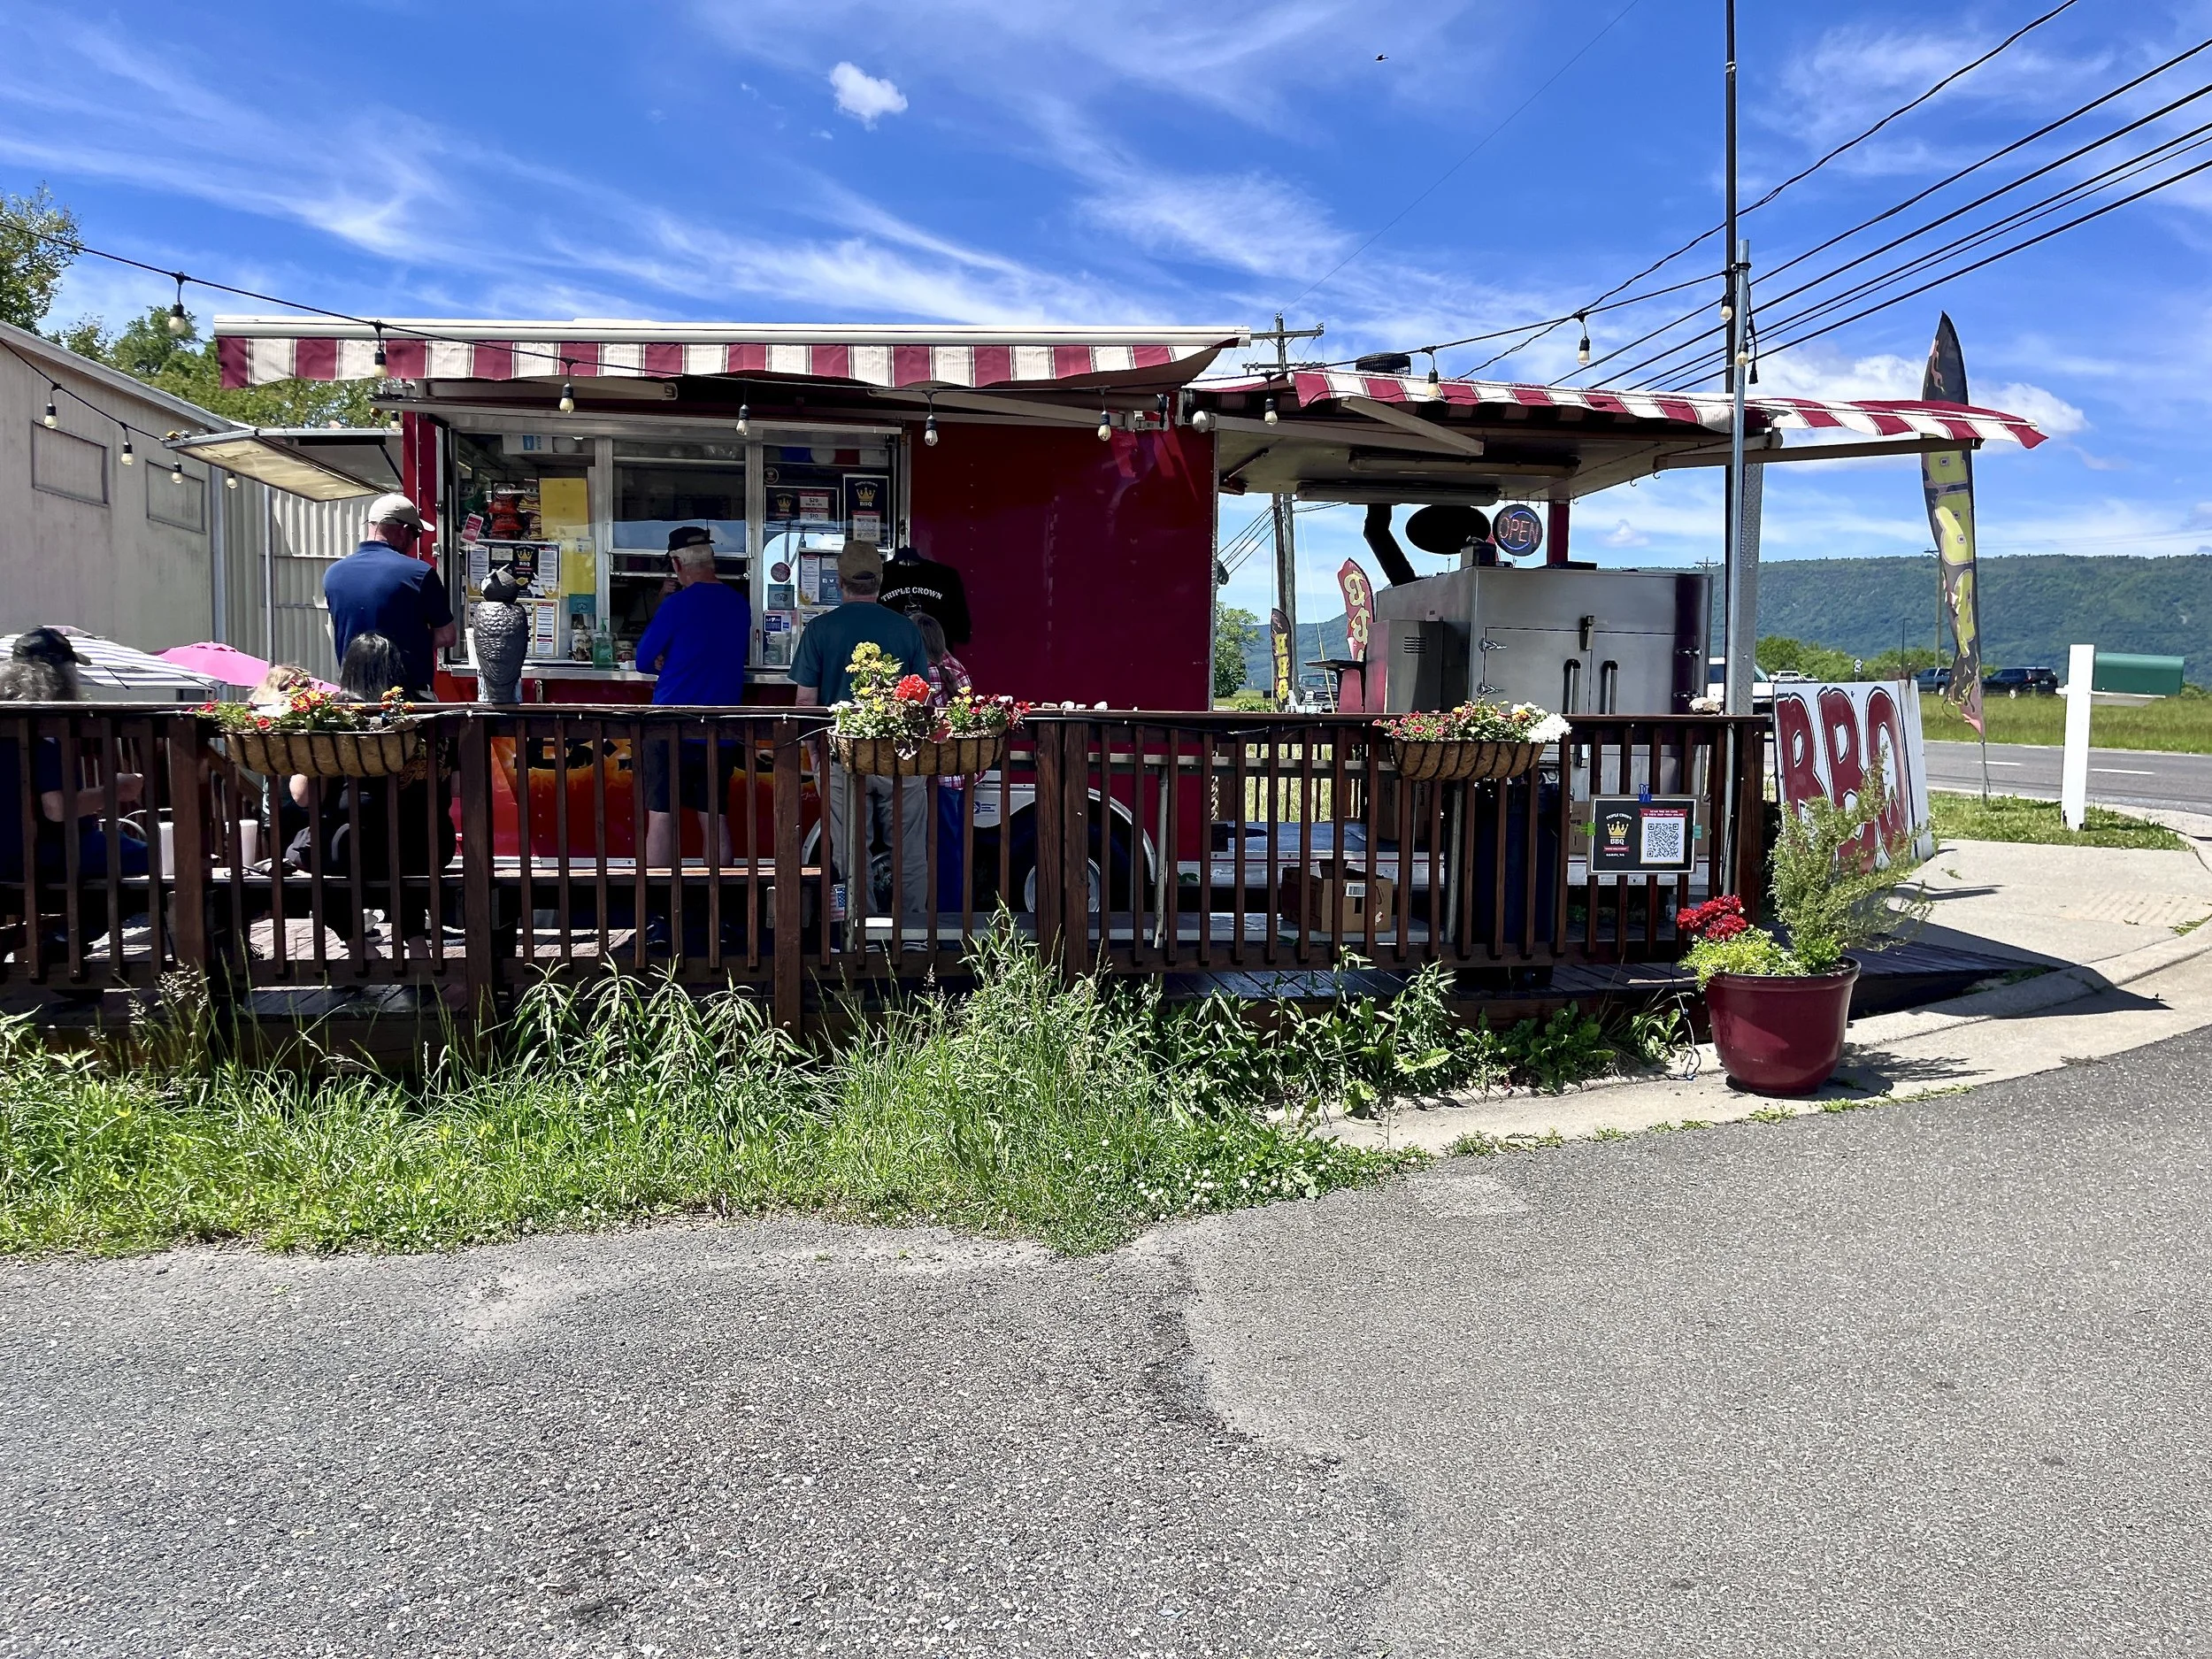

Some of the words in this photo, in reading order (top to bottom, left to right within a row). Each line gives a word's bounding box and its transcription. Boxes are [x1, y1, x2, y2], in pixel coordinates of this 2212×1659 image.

[1500, 517, 1540, 544] OPEN
[880, 587, 910, 603] TRIPLE
[911, 587, 943, 601] CROWN
